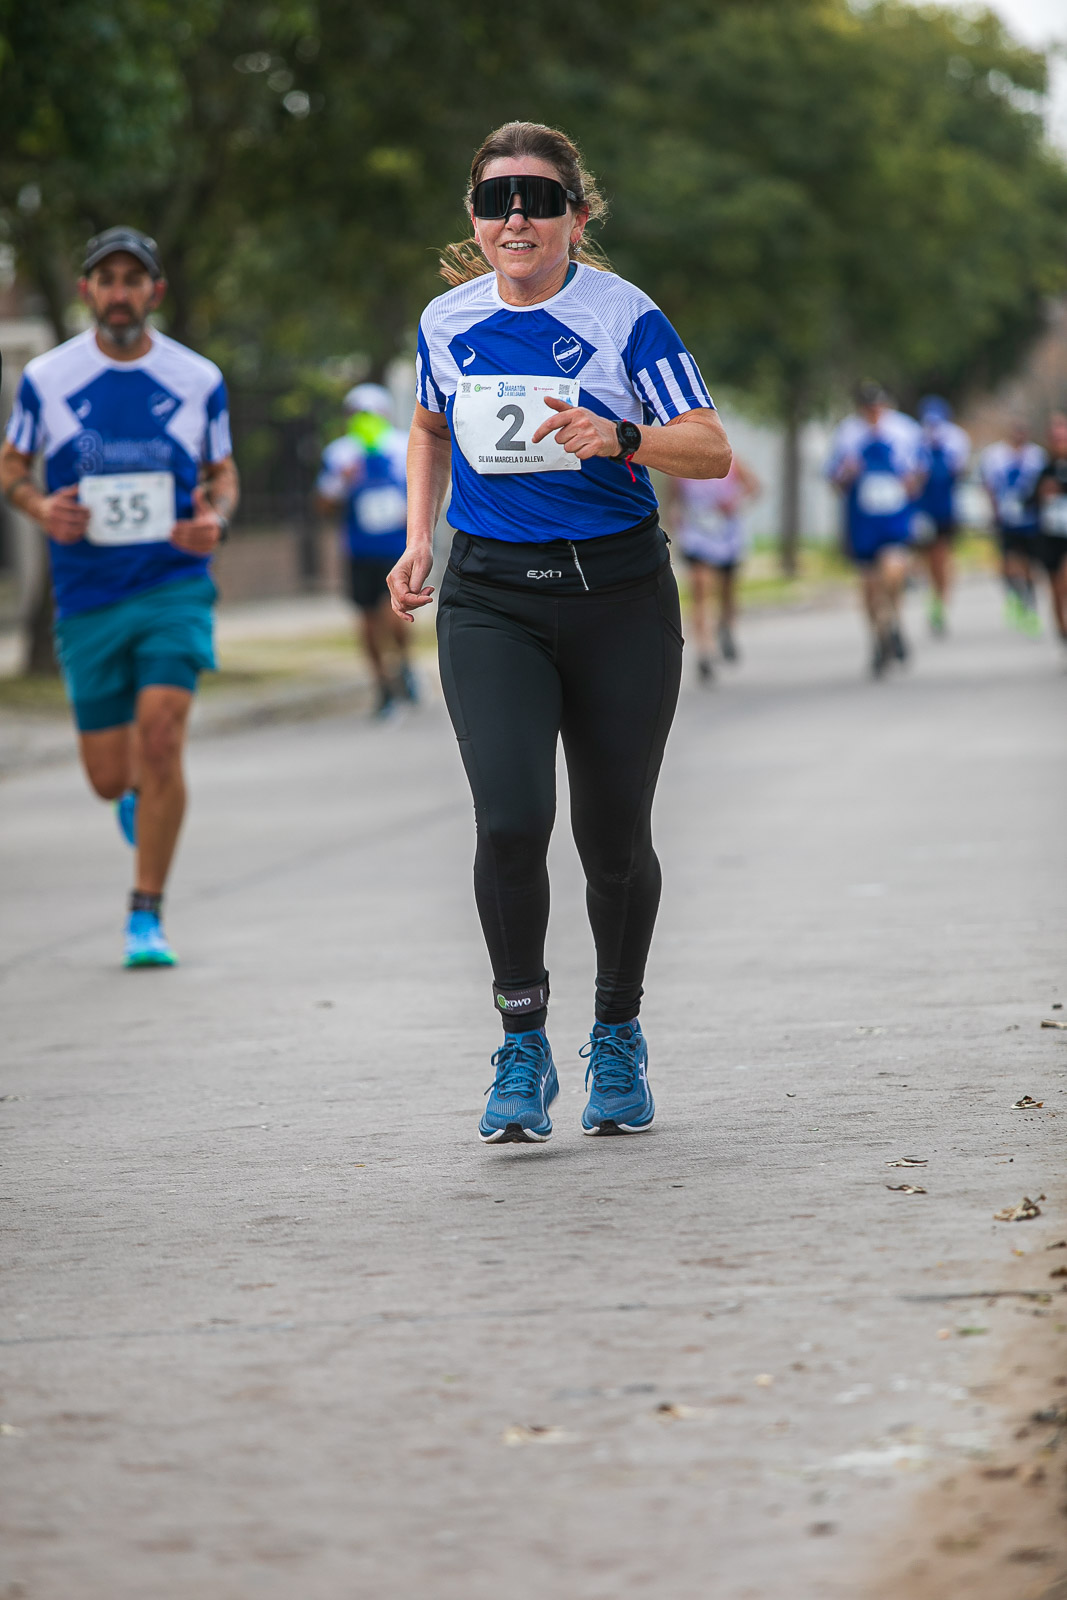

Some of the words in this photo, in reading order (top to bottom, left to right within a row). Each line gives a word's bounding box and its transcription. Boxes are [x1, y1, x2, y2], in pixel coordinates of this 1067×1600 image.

[495, 404, 526, 451] 2
[478, 455, 494, 463] SILVIA
[494, 455, 519, 463] MARCELA
[519, 455, 524, 463] D
[524, 455, 545, 463] ALLEVA
[104, 492, 150, 528] 35
